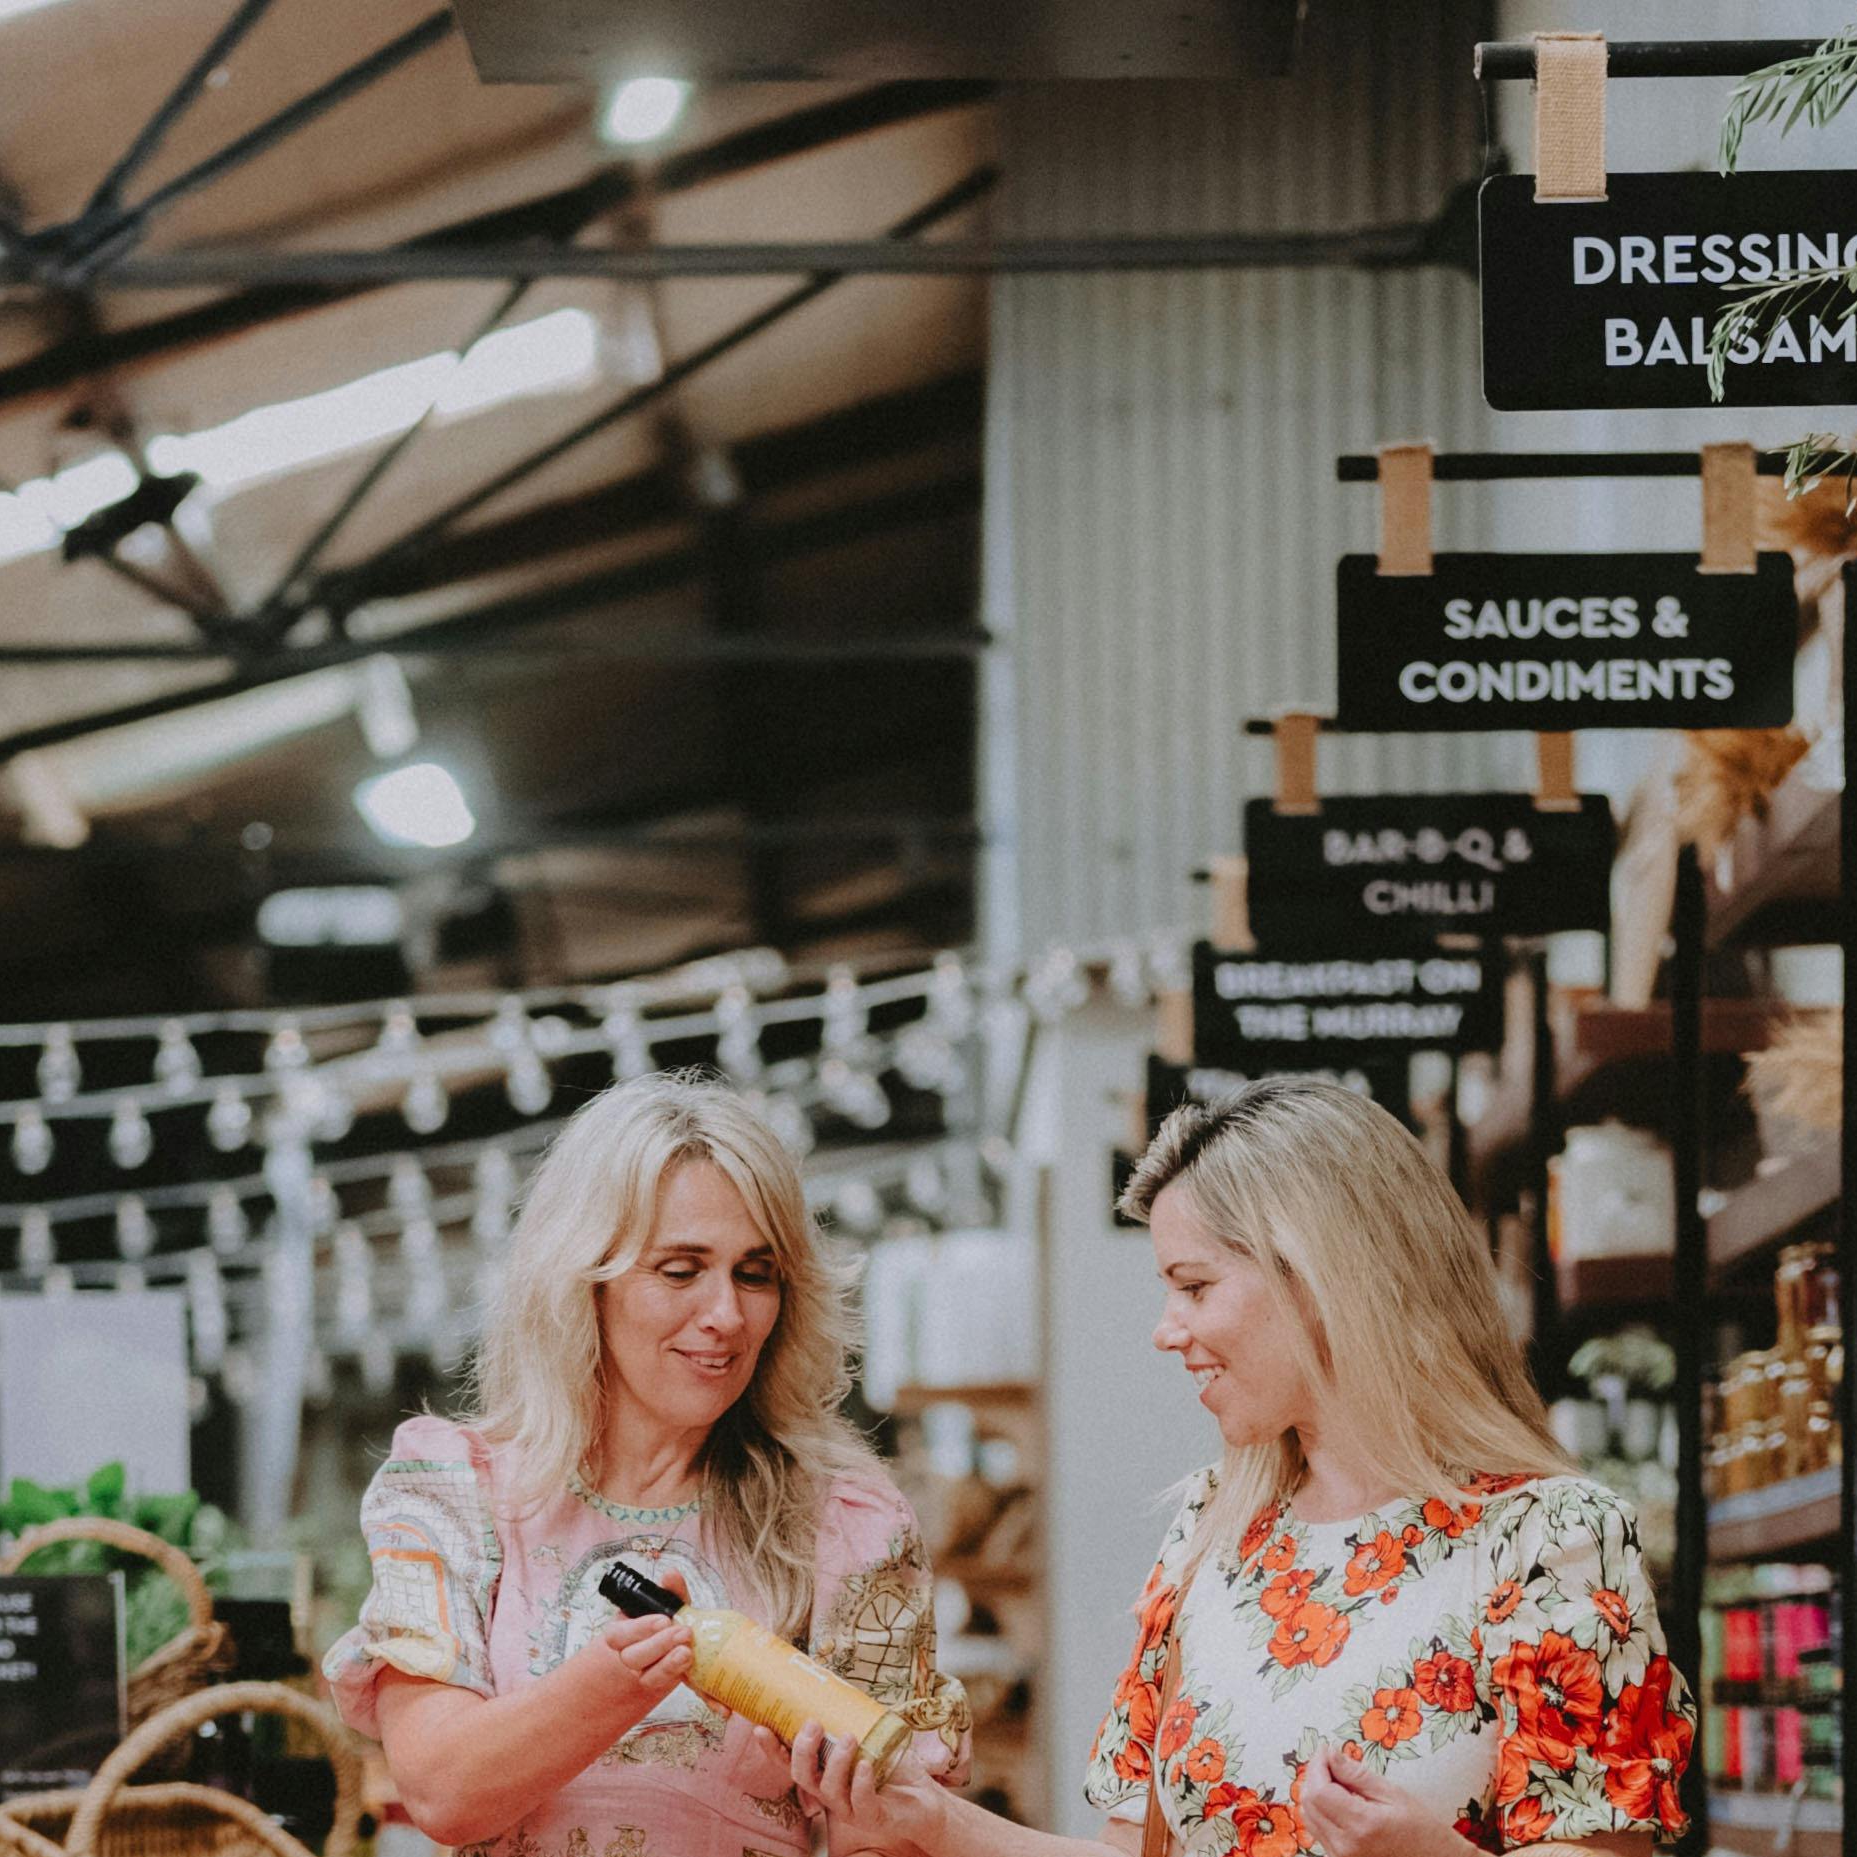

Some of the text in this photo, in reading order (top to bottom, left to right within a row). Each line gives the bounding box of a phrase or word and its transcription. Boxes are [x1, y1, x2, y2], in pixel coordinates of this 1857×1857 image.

[1443, 597, 1689, 640] SAUCES &
[1399, 658, 1735, 702] CONDIMENTS
[1322, 827, 1533, 872] BAR-B-Q &
[1362, 879, 1495, 915] CHILLI
[1416, 957, 1483, 997] ON
[1234, 1002, 1464, 1041] THE MURRAY
